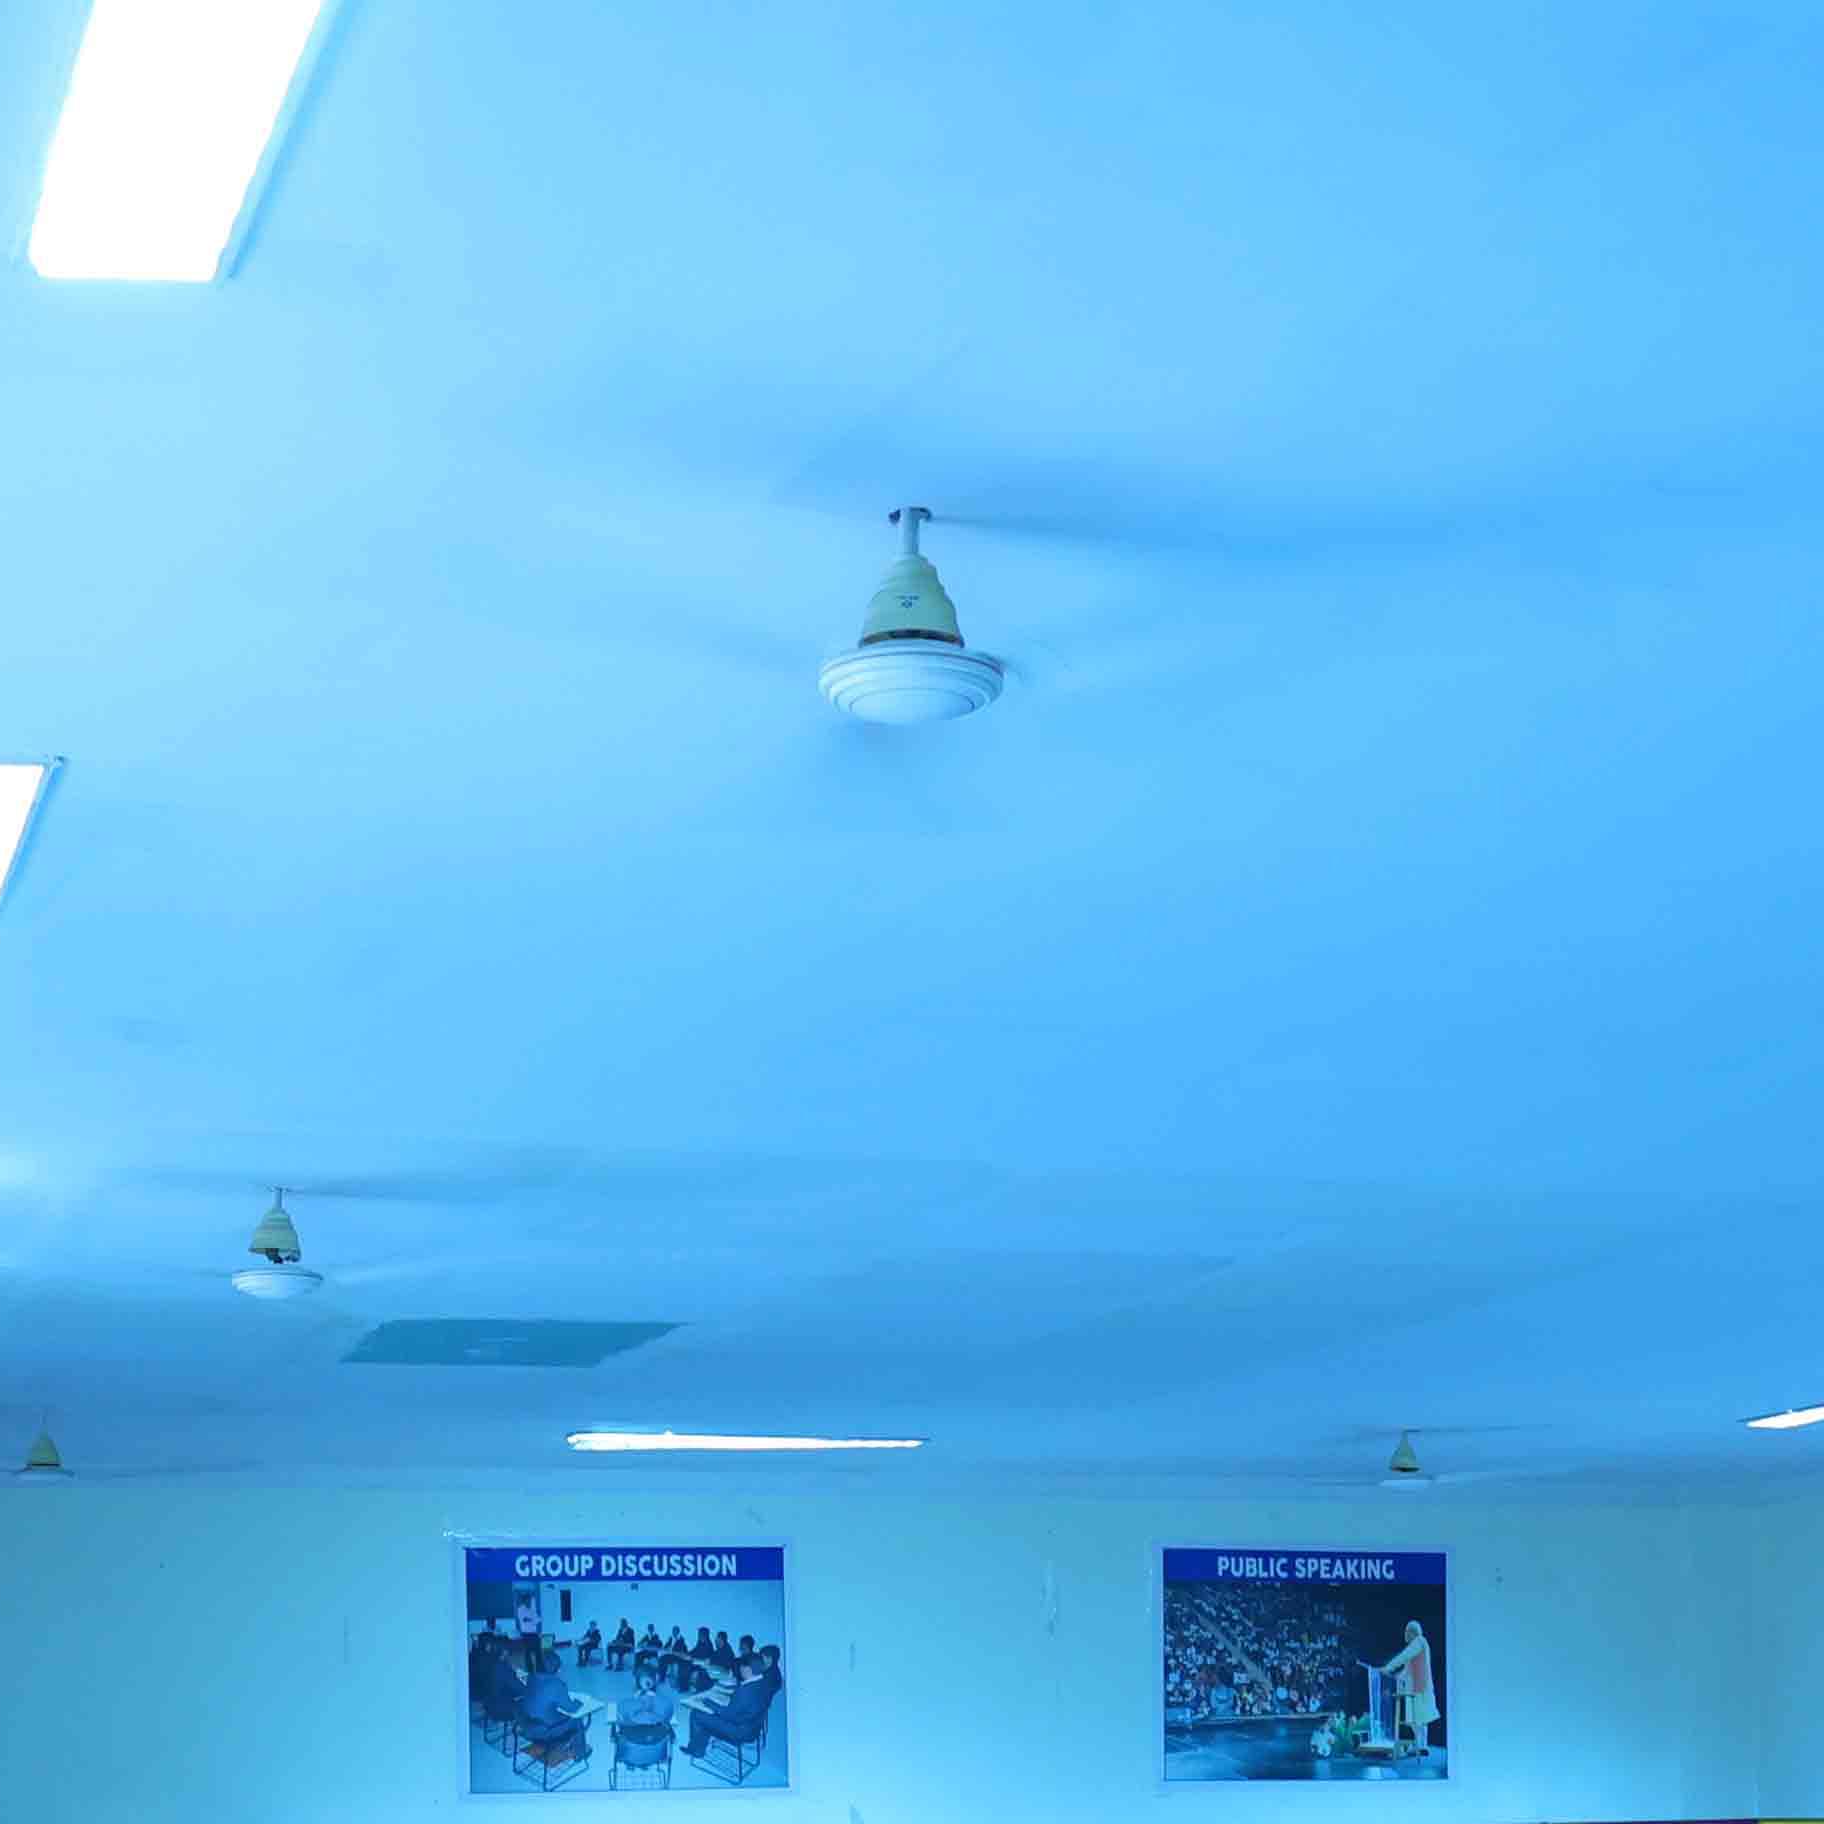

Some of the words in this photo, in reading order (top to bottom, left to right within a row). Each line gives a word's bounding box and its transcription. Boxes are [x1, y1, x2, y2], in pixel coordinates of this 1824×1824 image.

[515, 1554, 594, 1577] GROUP
[600, 1553, 737, 1577] DISCUSSION
[1216, 1556, 1289, 1578] PUBLIC
[1295, 1557, 1395, 1580] SPEAKING
